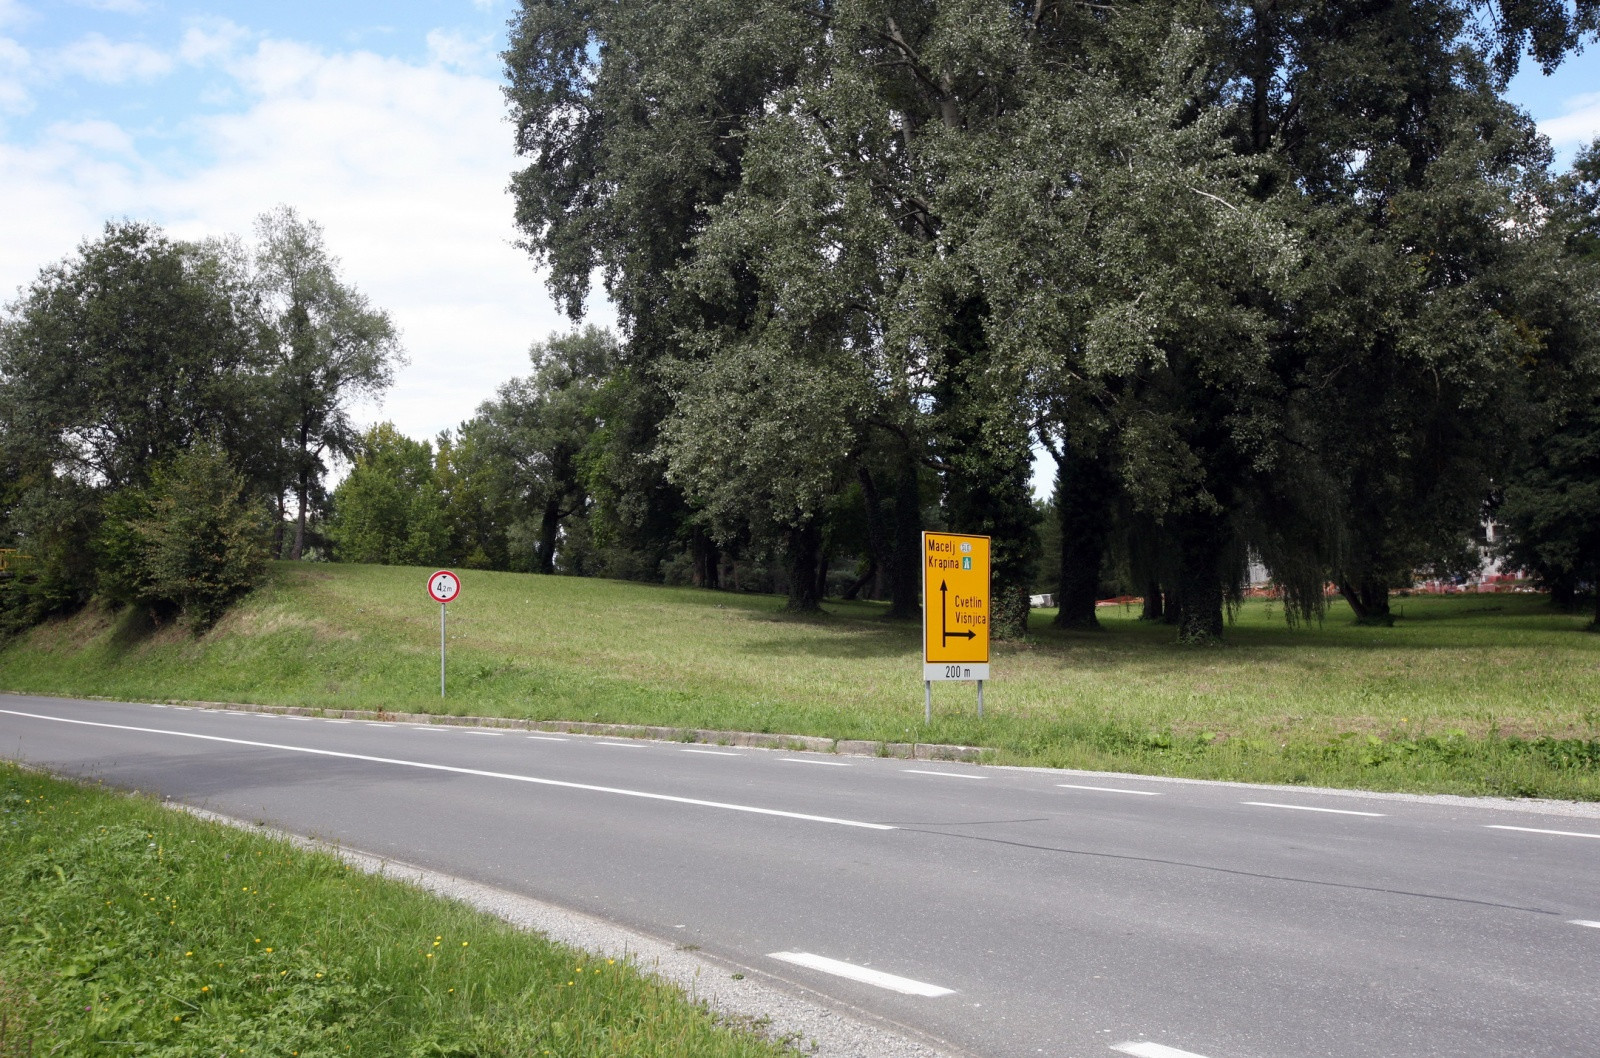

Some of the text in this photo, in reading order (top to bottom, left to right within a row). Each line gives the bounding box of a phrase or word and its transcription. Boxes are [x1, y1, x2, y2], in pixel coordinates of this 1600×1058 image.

[928, 539, 955, 556] Macelj
[928, 555, 959, 571] Krapina
[955, 595, 982, 608] Cvetlin
[955, 611, 986, 627] Višnjica
[945, 665, 971, 678] 200 m
